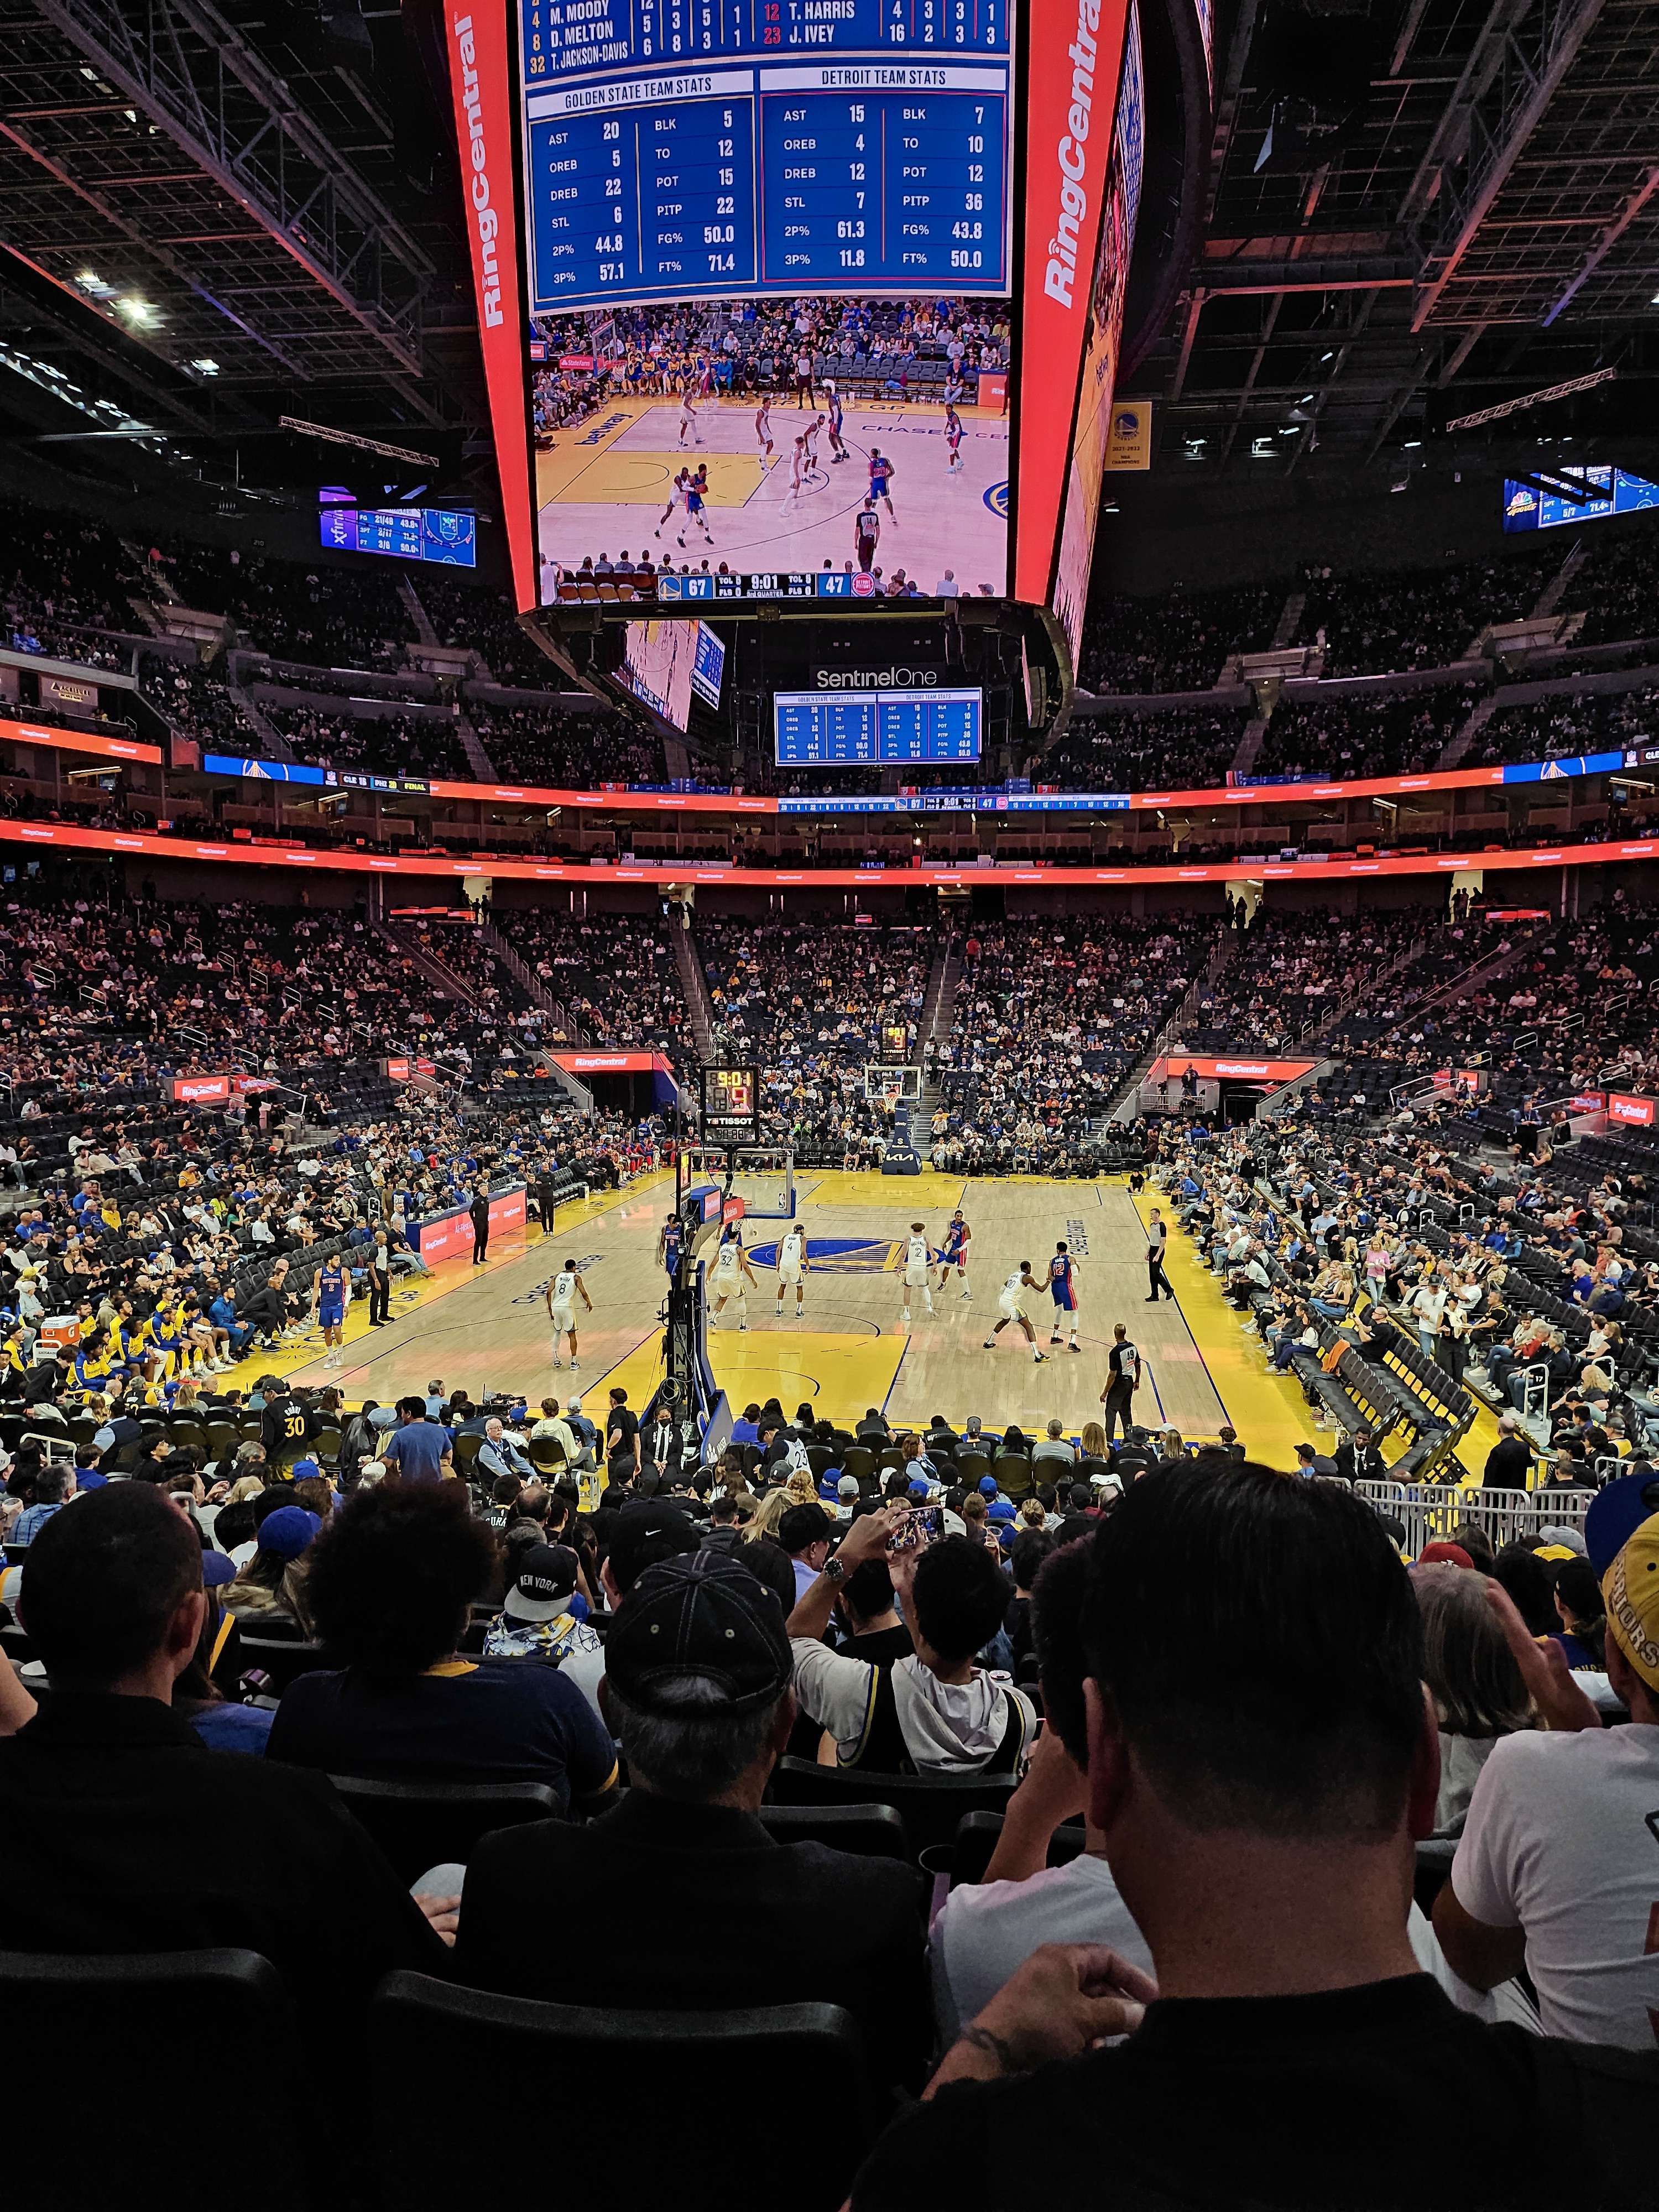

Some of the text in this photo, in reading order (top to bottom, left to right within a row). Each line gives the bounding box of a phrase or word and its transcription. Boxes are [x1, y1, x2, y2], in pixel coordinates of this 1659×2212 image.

[531, 0, 740, 33] 4 M. MOODY 5 3 5 1
[764, 1, 994, 21] 12 T. HARRIS 4 3 3 1
[533, 20, 740, 56] 8 D. MELTON 6 8 3 1
[764, 24, 995, 44] 23 J. IVEY 16 2 3 3
[530, 41, 628, 75] 32 T. JACKSON-DAVIS
[822, 70, 946, 85] DETROIT TEAM STATS
[565, 77, 711, 108] GOLDEN STATE TEAM STATS
[655, 110, 732, 131] BLK 5
[784, 105, 864, 122] AST 15
[902, 106, 983, 124] BLK 7
[549, 121, 619, 146] AST 20
[655, 139, 733, 159] TO 12
[784, 134, 864, 152] OREB 4
[902, 135, 983, 153] TO 10
[550, 149, 620, 173] OREB 5
[454, 14, 504, 328] RingCentral
[656, 168, 733, 187] POT 15
[785, 163, 865, 180] DREB 12
[902, 165, 983, 182] POT 12
[550, 178, 622, 201] DREB 22
[657, 196, 734, 216] PITP 22
[785, 191, 864, 209] STL 7
[902, 193, 983, 211] PITP 36
[552, 206, 622, 228] STL 6
[658, 225, 734, 244] FG% 50.0
[784, 221, 864, 238] 2P% 61.3
[902, 221, 982, 239] FG% 43.8
[552, 234, 623, 257] 2P% 44.8
[659, 253, 735, 273] FT% 71.4
[785, 249, 865, 267] 3P% 11.8
[902, 250, 982, 268] FT% 50.0
[554, 262, 624, 284] 3P% 57.1
[573, 412, 634, 446] betway
[862, 425, 942, 435] CHASE
[688, 579, 706, 596] 67
[752, 575, 778, 589] 9:01
[805, 586, 811, 596] 0
[826, 576, 843, 593] 47
[735, 587, 741, 597] 0
[817, 667, 937, 688] SentinelOne
[404, 782, 426, 791] FINAL
[982, 799, 992, 807] 47
[894, 1035, 906, 1048] 9
[574, 1056, 627, 1068] RingCentral
[1215, 1063, 1268, 1074] RingCentral
[717, 1071, 752, 1087] 9:01
[181, 1082, 223, 1097] RingCentral
[731, 1086, 748, 1114] 9
[425, 1234, 447, 1251] RingCentral
[1066, 1219, 1089, 1255] CHASE CENTER
[787, 1242, 792, 1251] 4
[915, 1247, 922, 1258] 2
[721, 1255, 732, 1266] 32
[1053, 1262, 1064, 1276] 12
[328, 1284, 335, 1292] 2
[559, 1283, 566, 1294] 8
[1126, 1349, 1134, 1360] 49
[284, 1416, 305, 1438] 30
[794, 1449, 807, 1469] 23
[520, 1574, 559, 1593] NEW YORK
